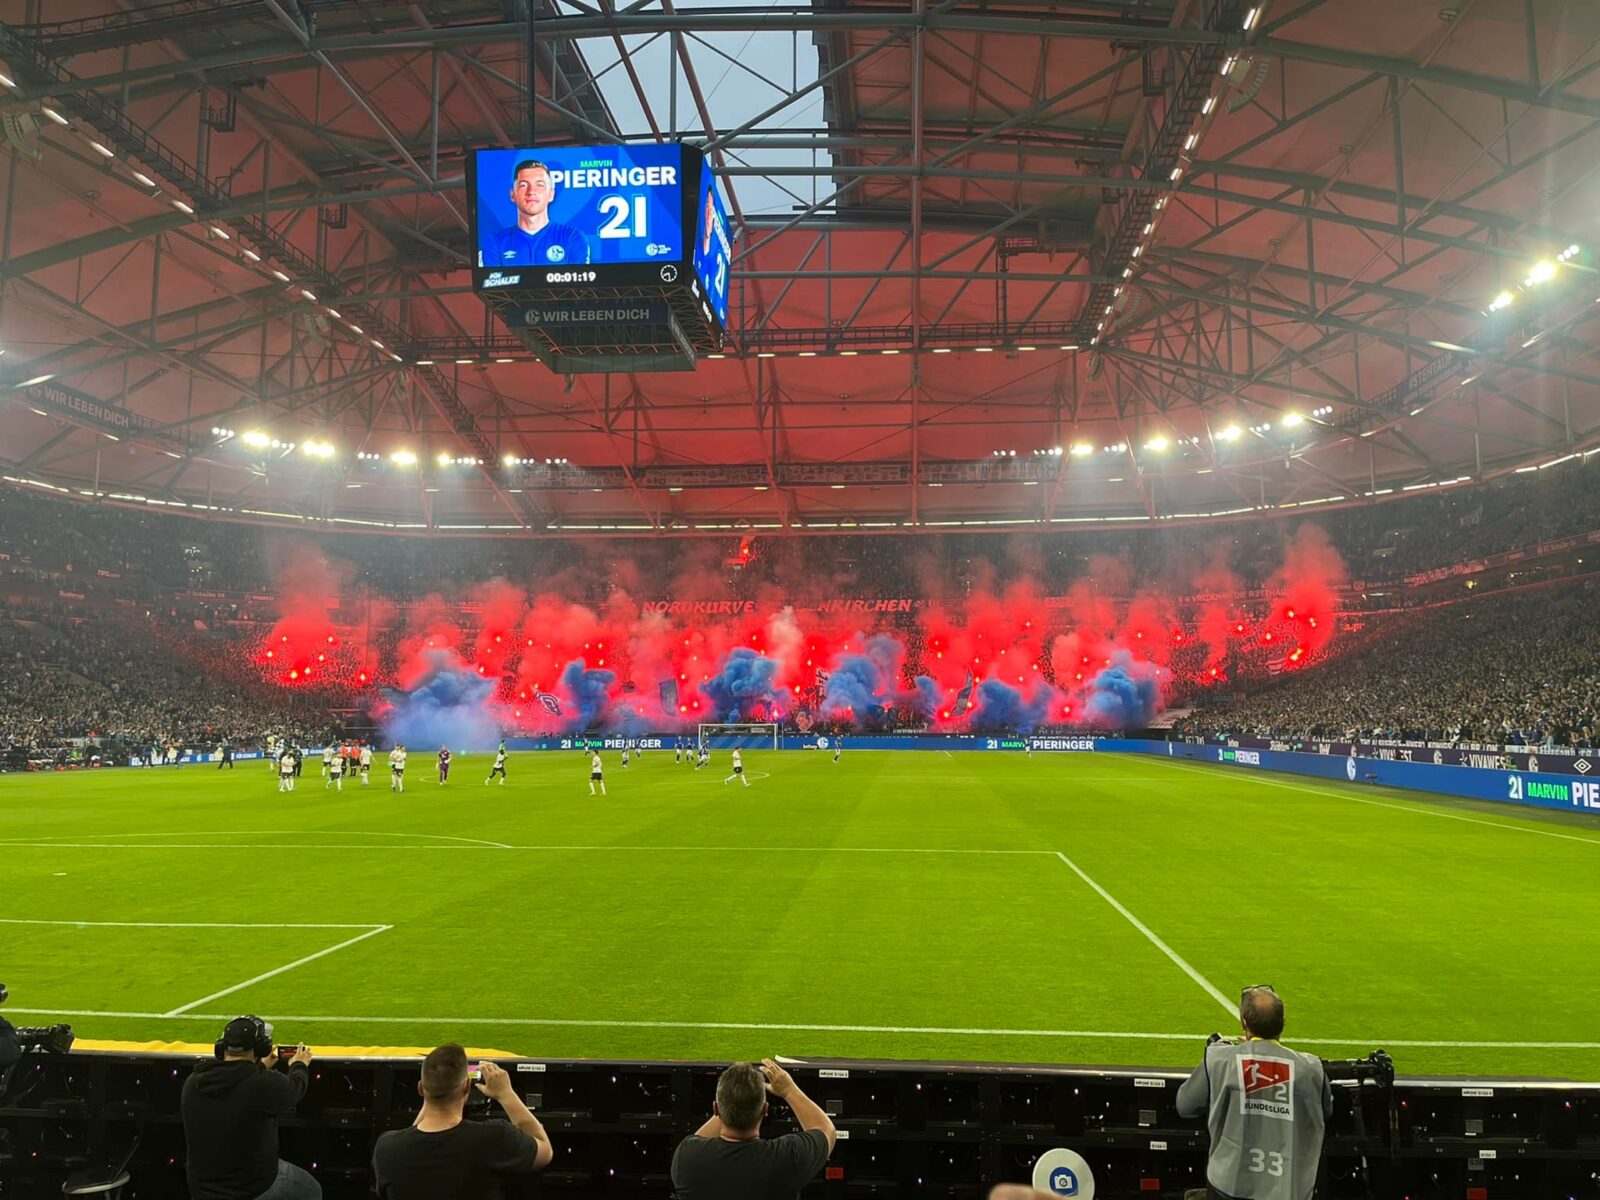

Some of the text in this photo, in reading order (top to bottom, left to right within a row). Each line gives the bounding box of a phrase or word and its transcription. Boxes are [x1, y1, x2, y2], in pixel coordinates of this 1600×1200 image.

[580, 160, 613, 168] MARVIN
[551, 166, 677, 188] PIERINGER
[599, 195, 647, 238] 21
[546, 271, 597, 283] 00:01:19
[543, 308, 650, 322] WIR LEBEN DICH
[44, 386, 129, 429] WIR LEBEN DICH
[642, 600, 755, 615] NORDKURVE
[986, 740, 998, 749] 21
[1033, 740, 1093, 750] PIERINGER
[1469, 753, 1507, 771] VIVAWES
[1508, 775, 1524, 800] 21
[1527, 782, 1569, 801] MARVIN
[1274, 1083, 1287, 1101] 2
[1244, 1102, 1290, 1115] BUNDESLIGA
[1248, 1148, 1283, 1177] 33
